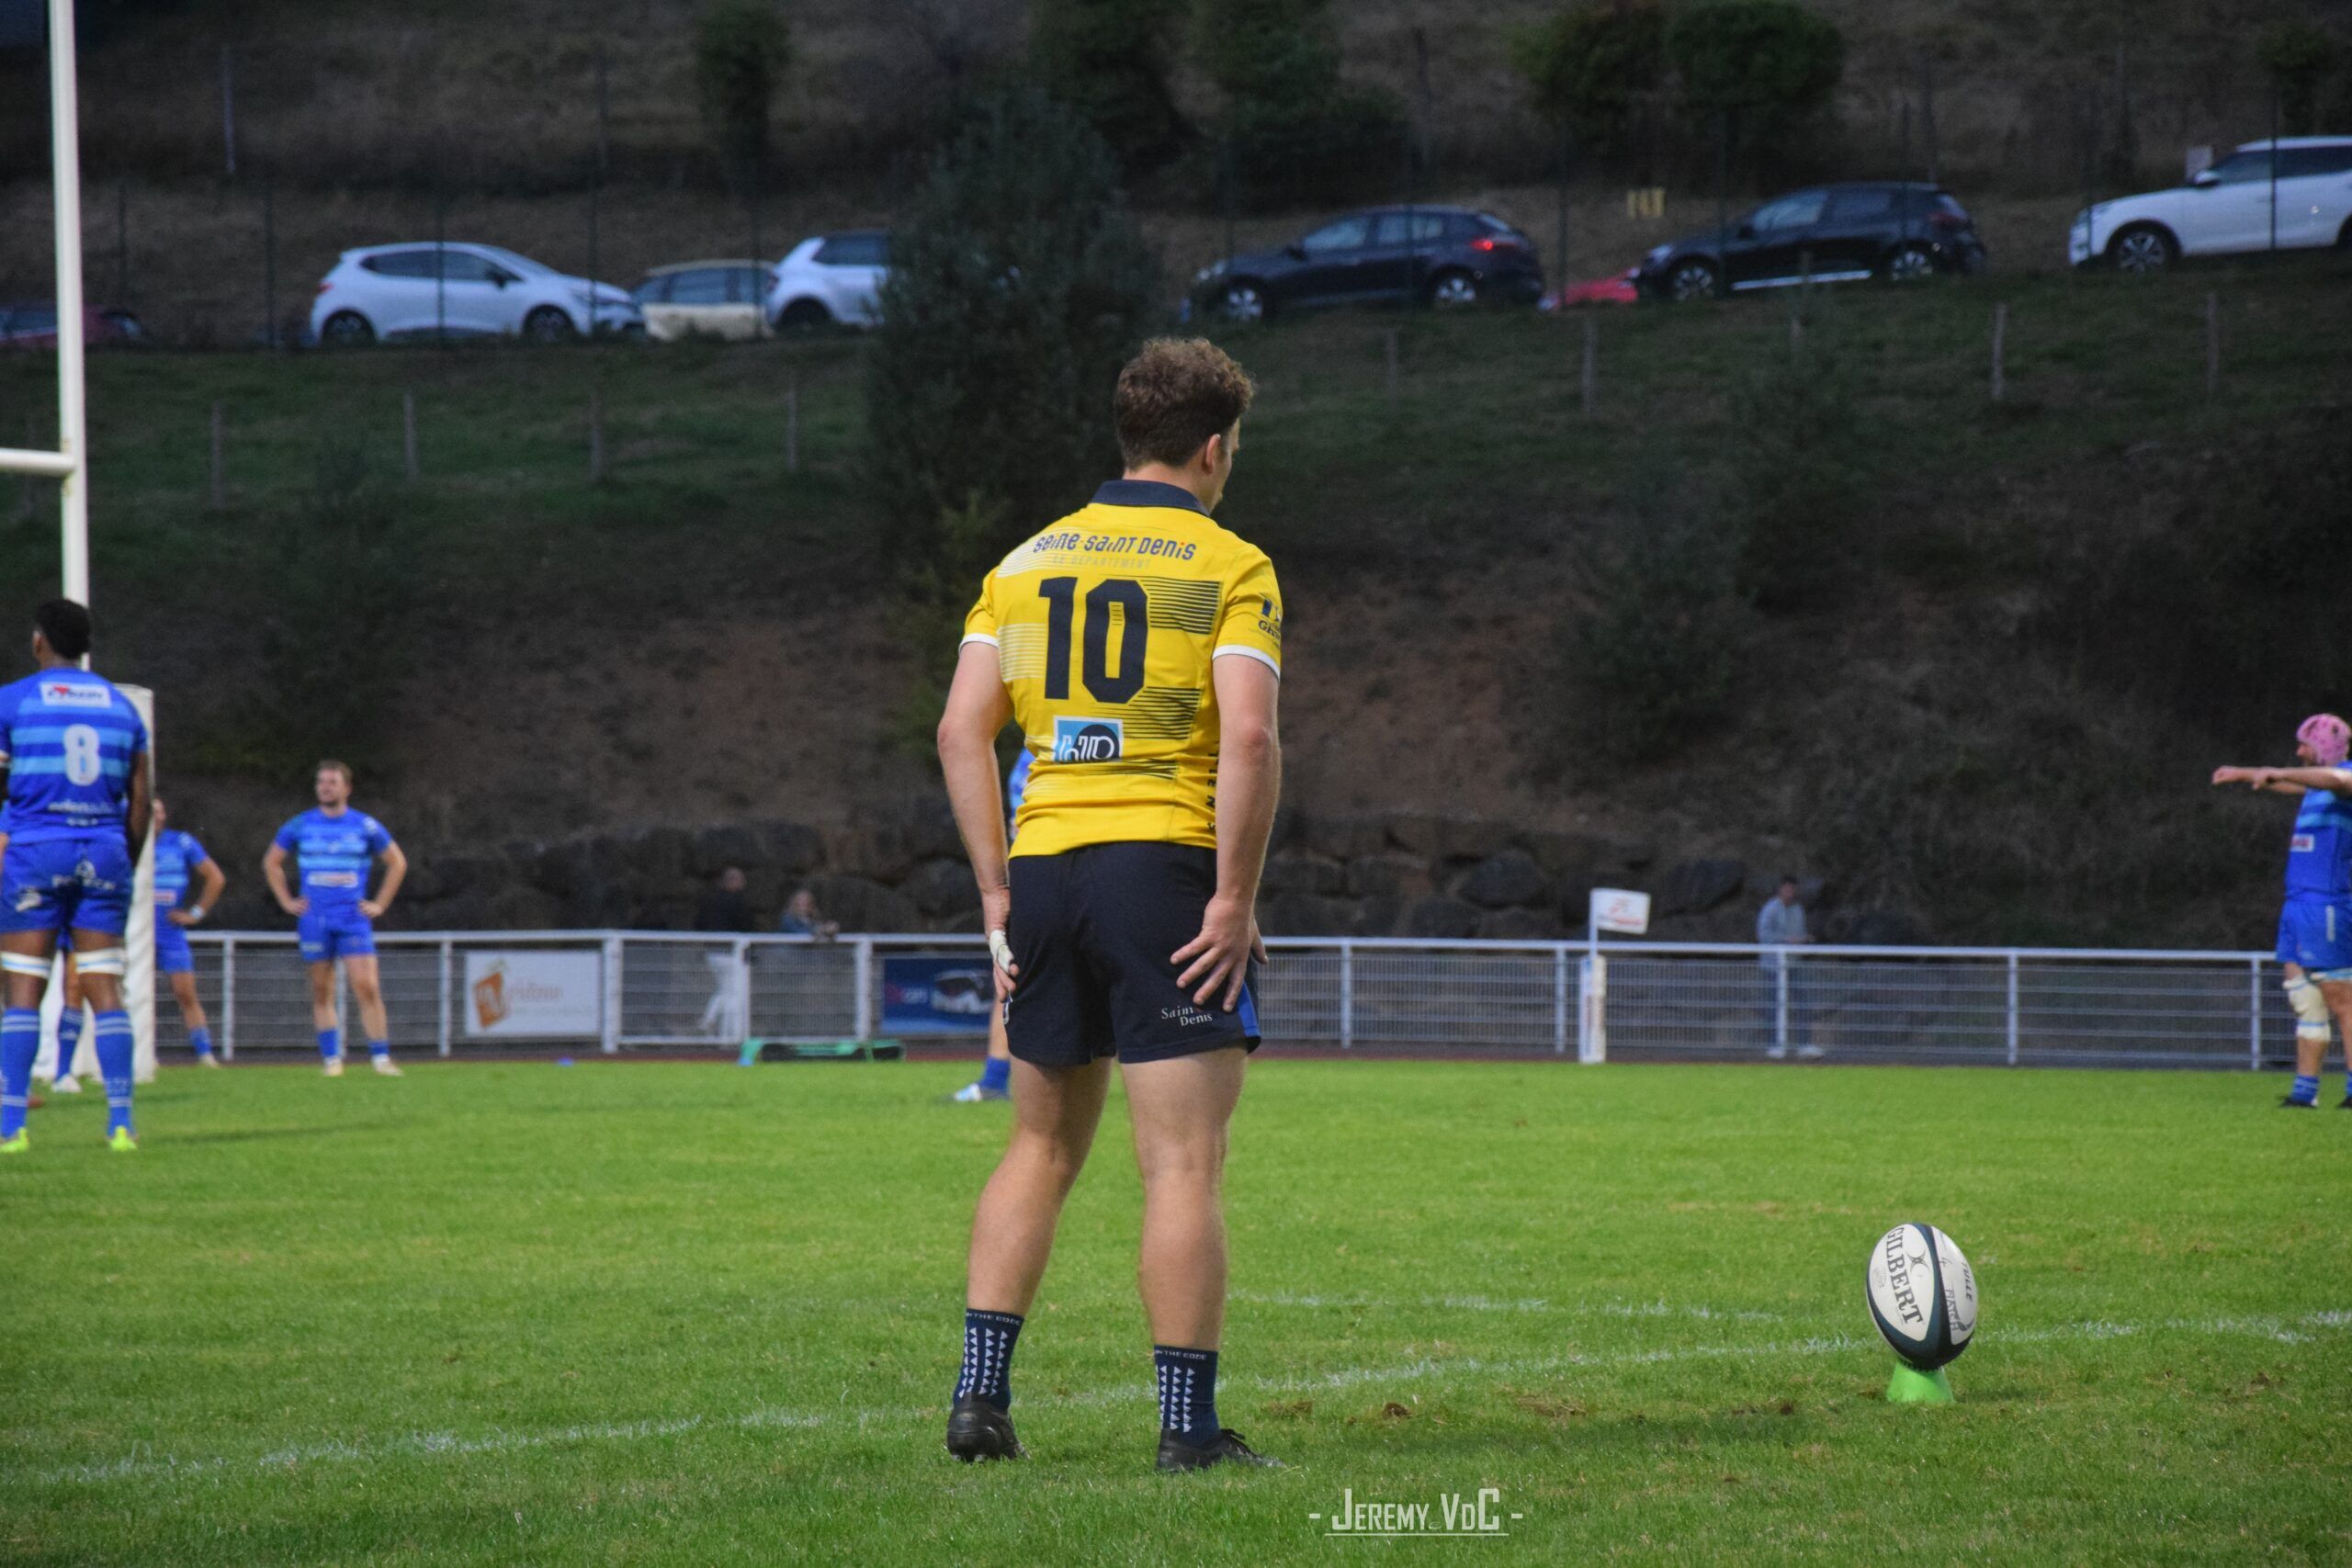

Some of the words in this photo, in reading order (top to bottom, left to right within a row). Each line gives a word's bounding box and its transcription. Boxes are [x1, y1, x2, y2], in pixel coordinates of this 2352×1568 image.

[1038, 576, 1148, 705] 10
[63, 722, 102, 786] 8
[1180, 1014, 1213, 1026] Denis
[1886, 1227, 1924, 1324] GILBERT
